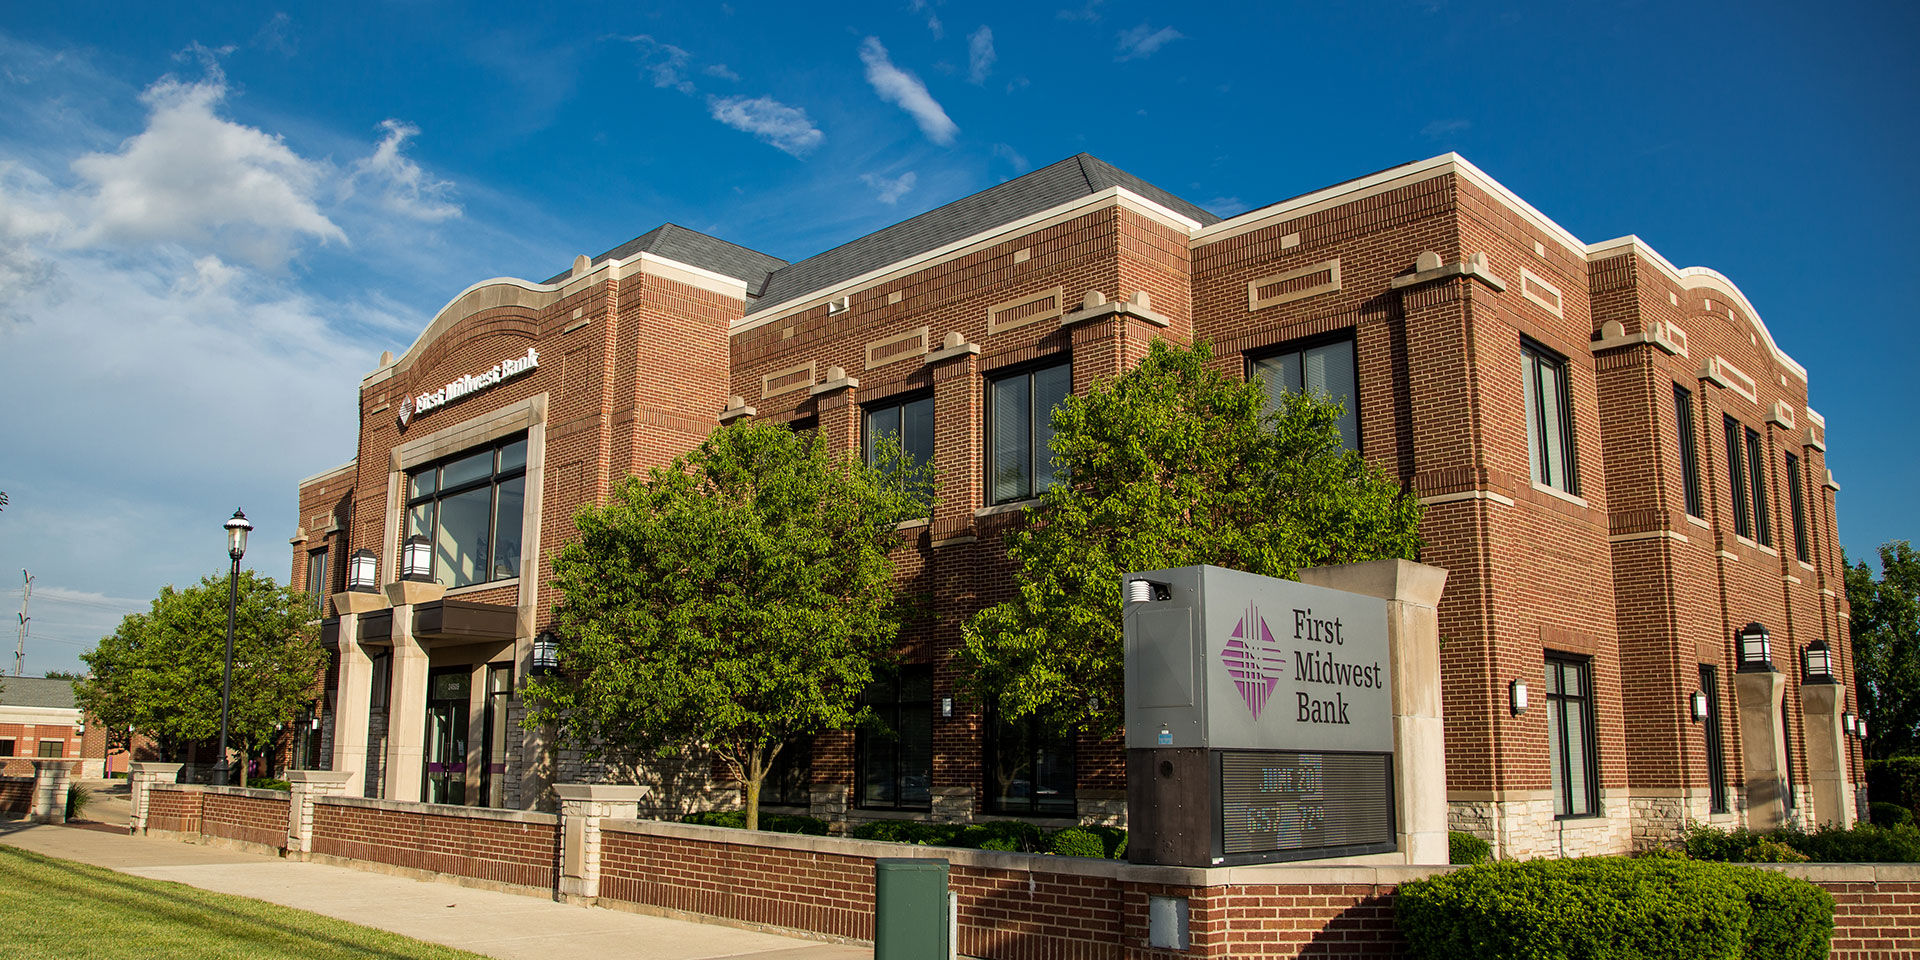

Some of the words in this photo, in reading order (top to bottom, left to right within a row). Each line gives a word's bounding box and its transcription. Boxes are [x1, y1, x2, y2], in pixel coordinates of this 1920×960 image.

[415, 389, 446, 413] First
[445, 365, 501, 401] Midwest
[501, 347, 540, 378] Bank
[1292, 608, 1344, 646] First
[1294, 650, 1382, 690] Midwest
[1296, 691, 1350, 725] Bank
